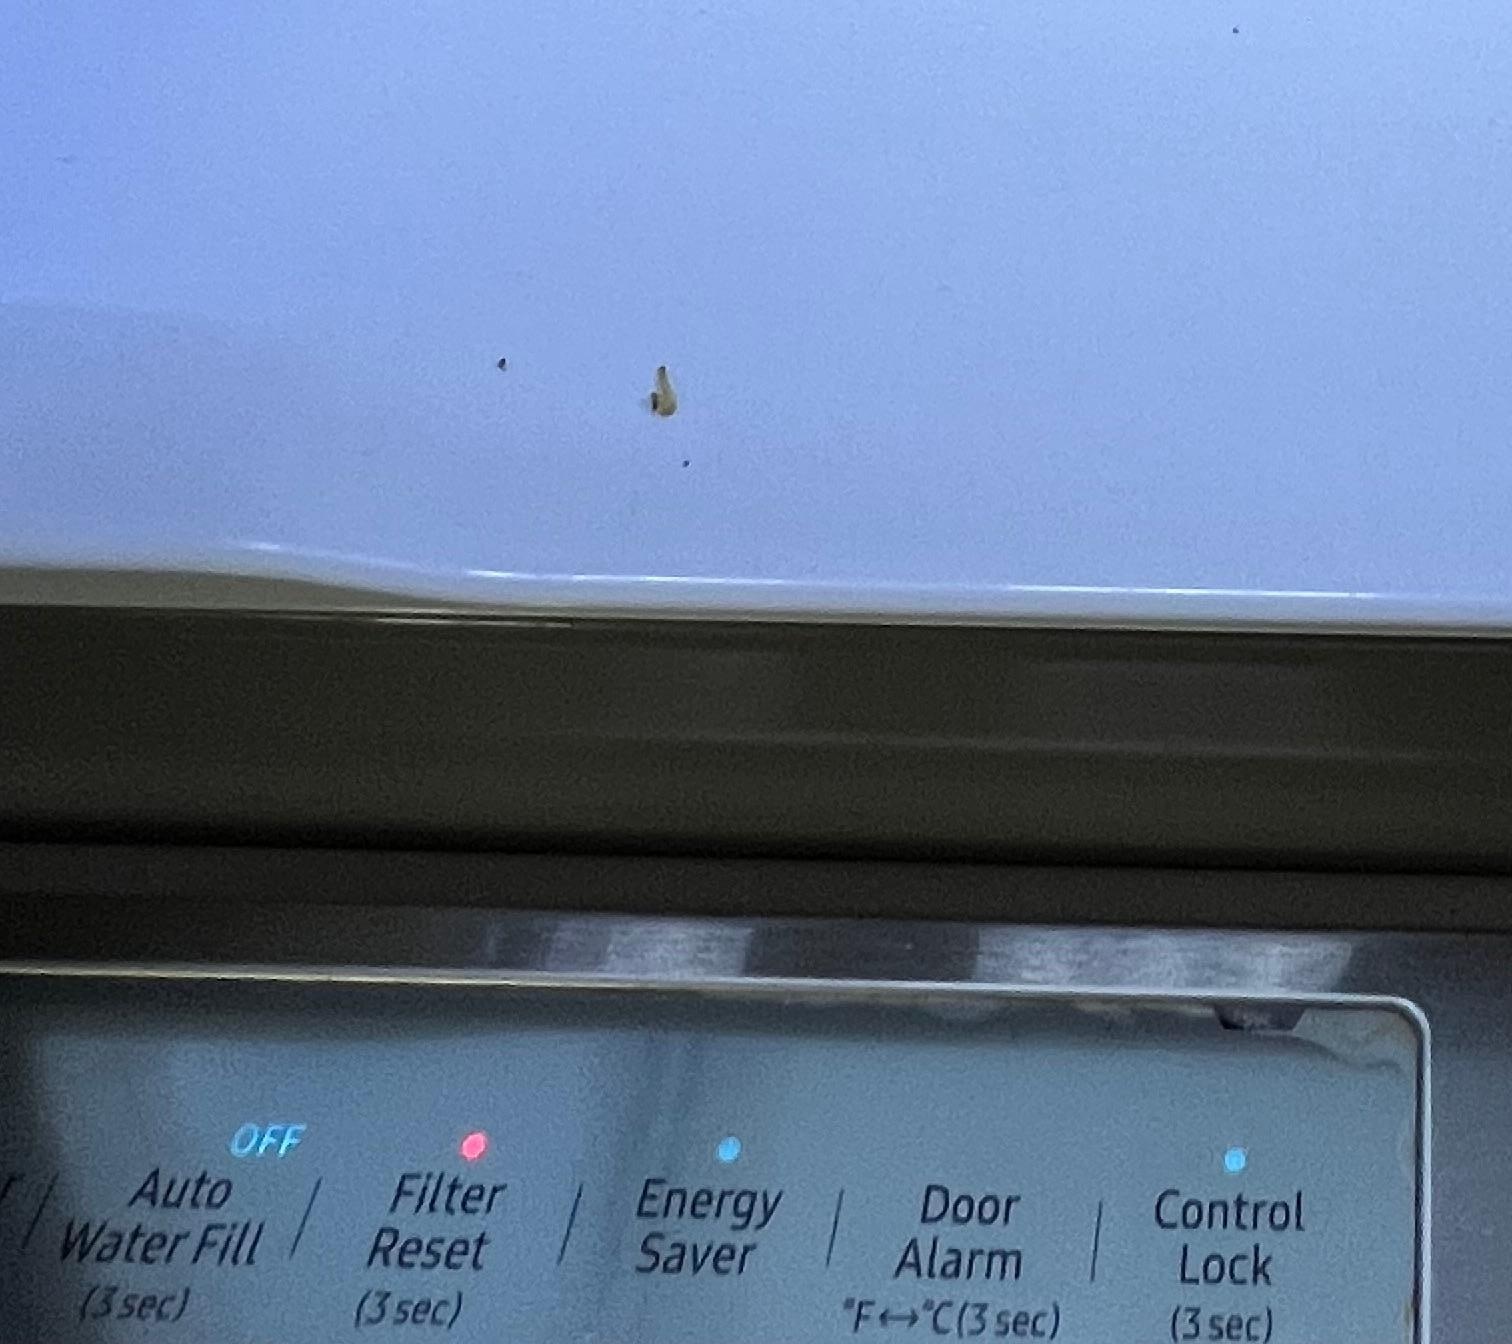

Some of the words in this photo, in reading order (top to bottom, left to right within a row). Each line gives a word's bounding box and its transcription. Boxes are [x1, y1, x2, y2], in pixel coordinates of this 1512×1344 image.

[230, 1122, 307, 1158] OFF
[128, 1166, 234, 1210] Auto
[389, 1169, 508, 1215] Filter
[635, 1177, 785, 1231] Energy
[920, 1183, 1022, 1226] Door
[1154, 1188, 1306, 1232] Control
[60, 1217, 190, 1265] Water
[191, 1219, 266, 1267] Fill
[366, 1225, 491, 1271] Reset
[635, 1231, 758, 1276] Saver
[892, 1234, 1023, 1282] Alarm
[1180, 1242, 1273, 1286] Lock
